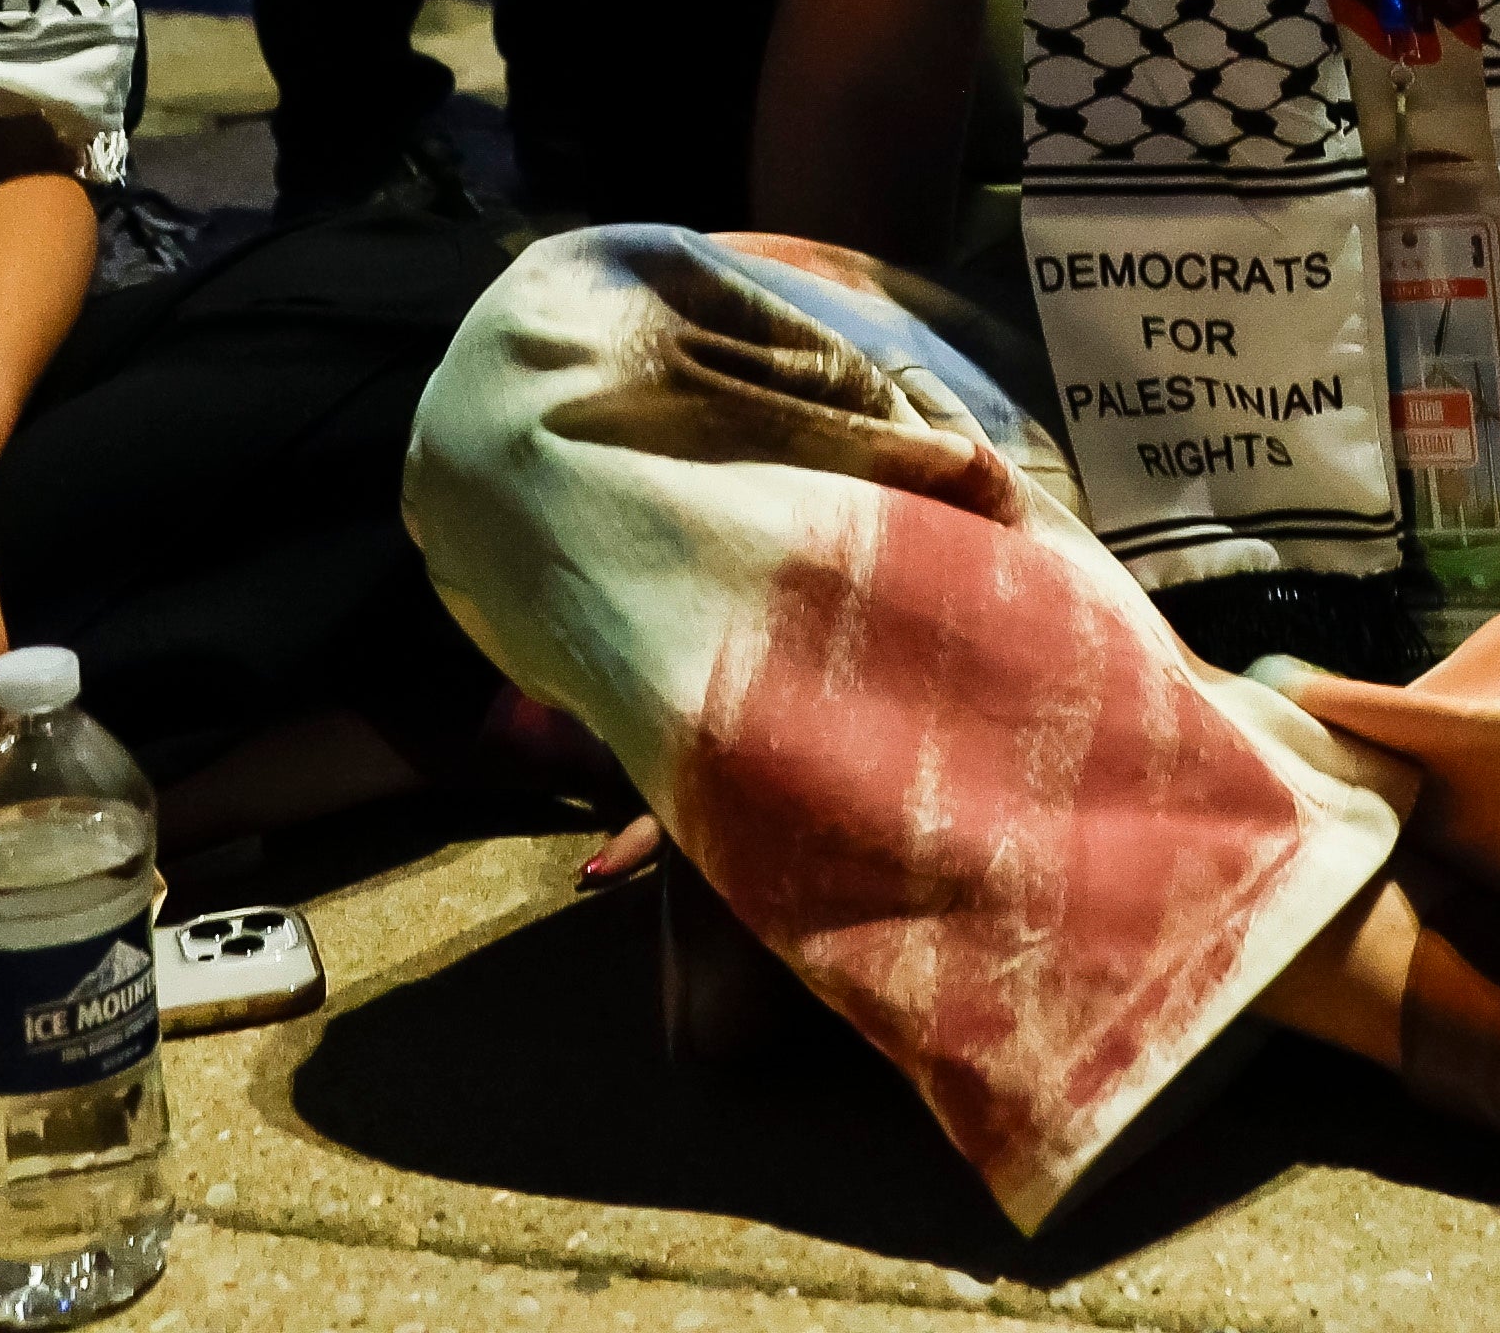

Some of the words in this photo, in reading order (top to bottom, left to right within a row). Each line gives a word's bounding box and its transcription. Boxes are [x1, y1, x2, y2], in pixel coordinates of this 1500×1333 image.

[1034, 251, 1332, 294] DEMOCRATS
[1141, 315, 1238, 357] FOR
[1065, 375, 1344, 422] PALESTINIAN
[1137, 433, 1293, 478] RIGHTS
[24, 1008, 69, 1043] ICE
